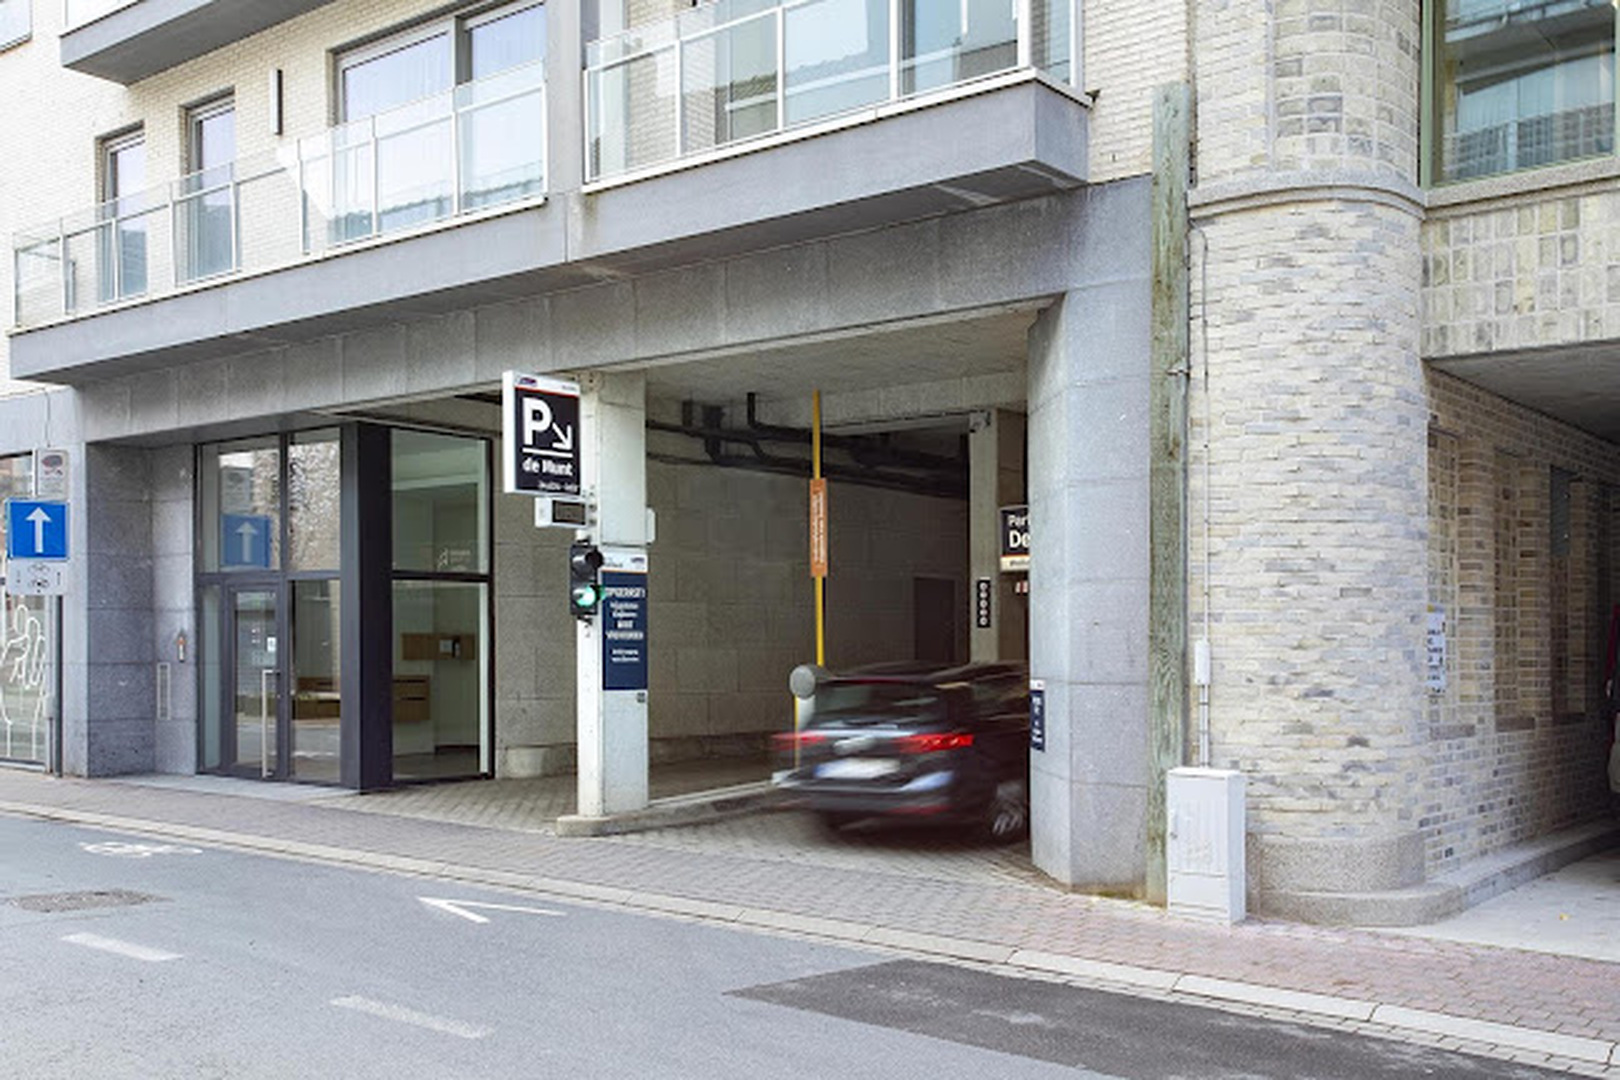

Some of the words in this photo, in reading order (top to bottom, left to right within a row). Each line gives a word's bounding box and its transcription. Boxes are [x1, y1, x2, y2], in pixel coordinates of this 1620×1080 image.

[522, 397, 552, 445] P
[523, 458, 539, 472] de
[1008, 514, 1030, 528] Par
